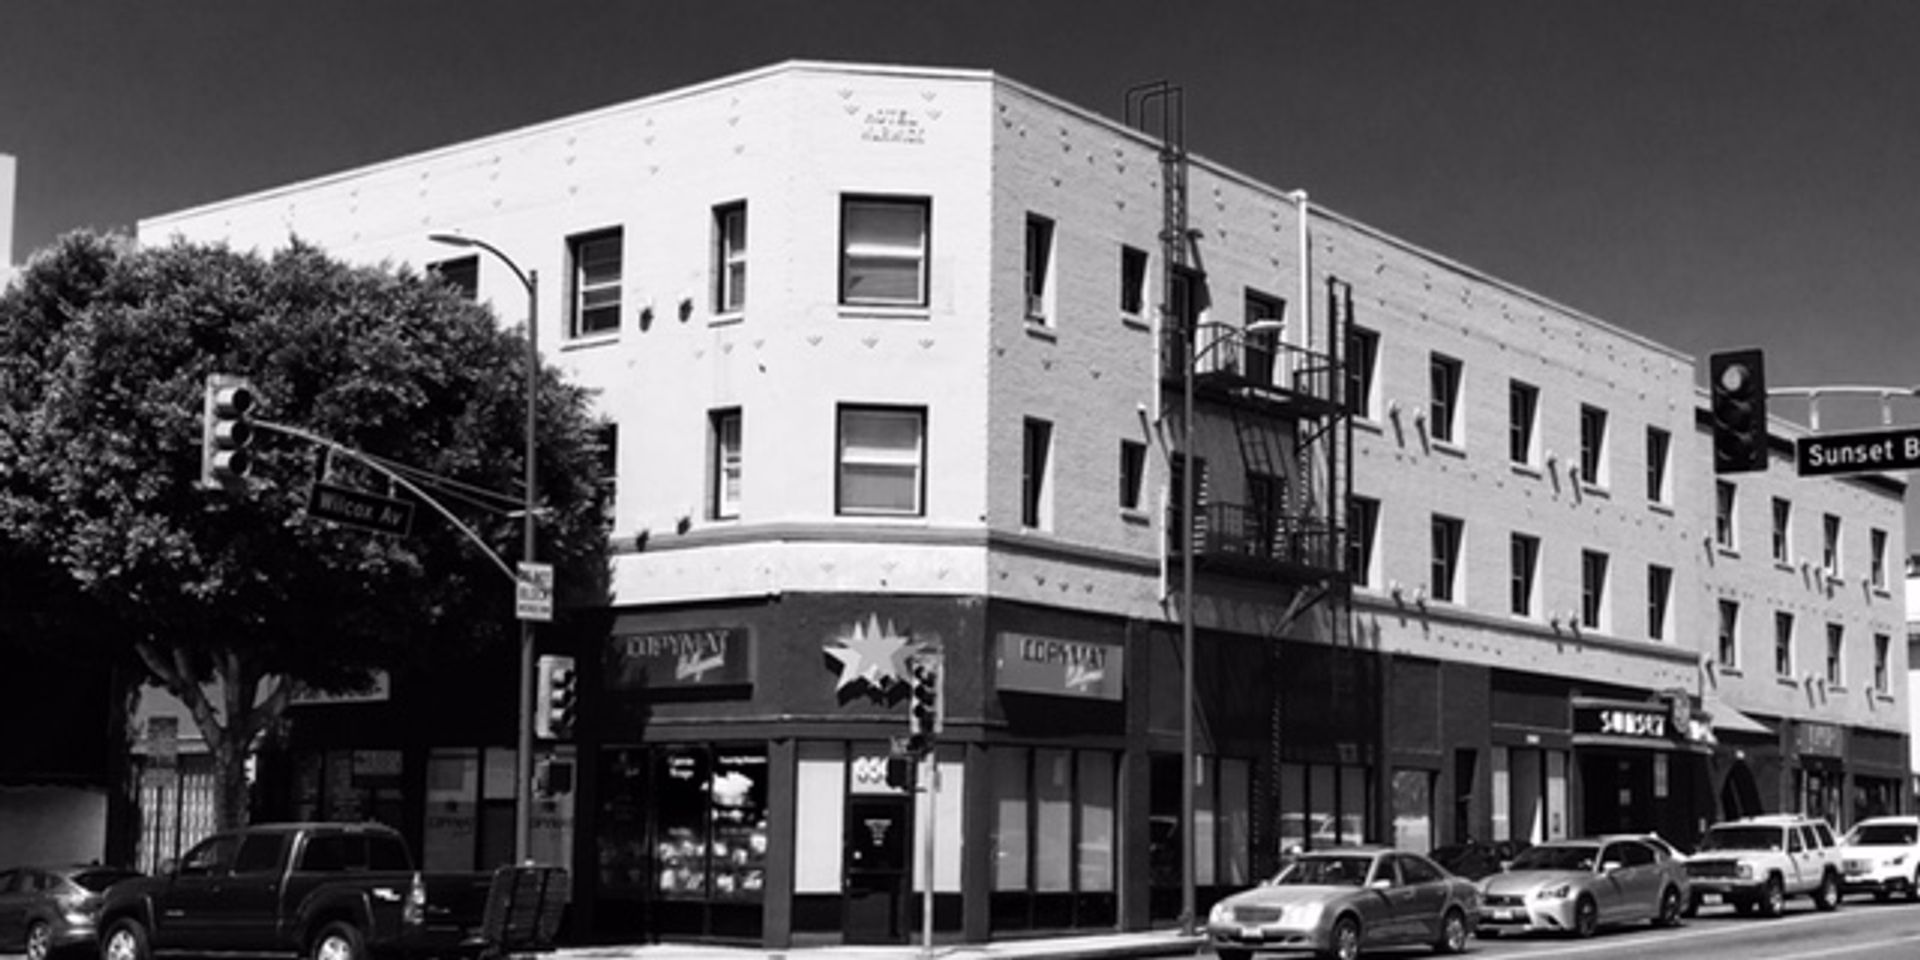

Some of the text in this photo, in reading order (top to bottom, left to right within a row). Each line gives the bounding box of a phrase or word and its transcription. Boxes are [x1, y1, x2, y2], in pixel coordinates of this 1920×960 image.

[1808, 440, 1894, 467] Sunset
[318, 490, 404, 527] Wilcox Av
[1019, 638, 1108, 669] COPYMAT
[1600, 711, 1666, 737] SUNSET
